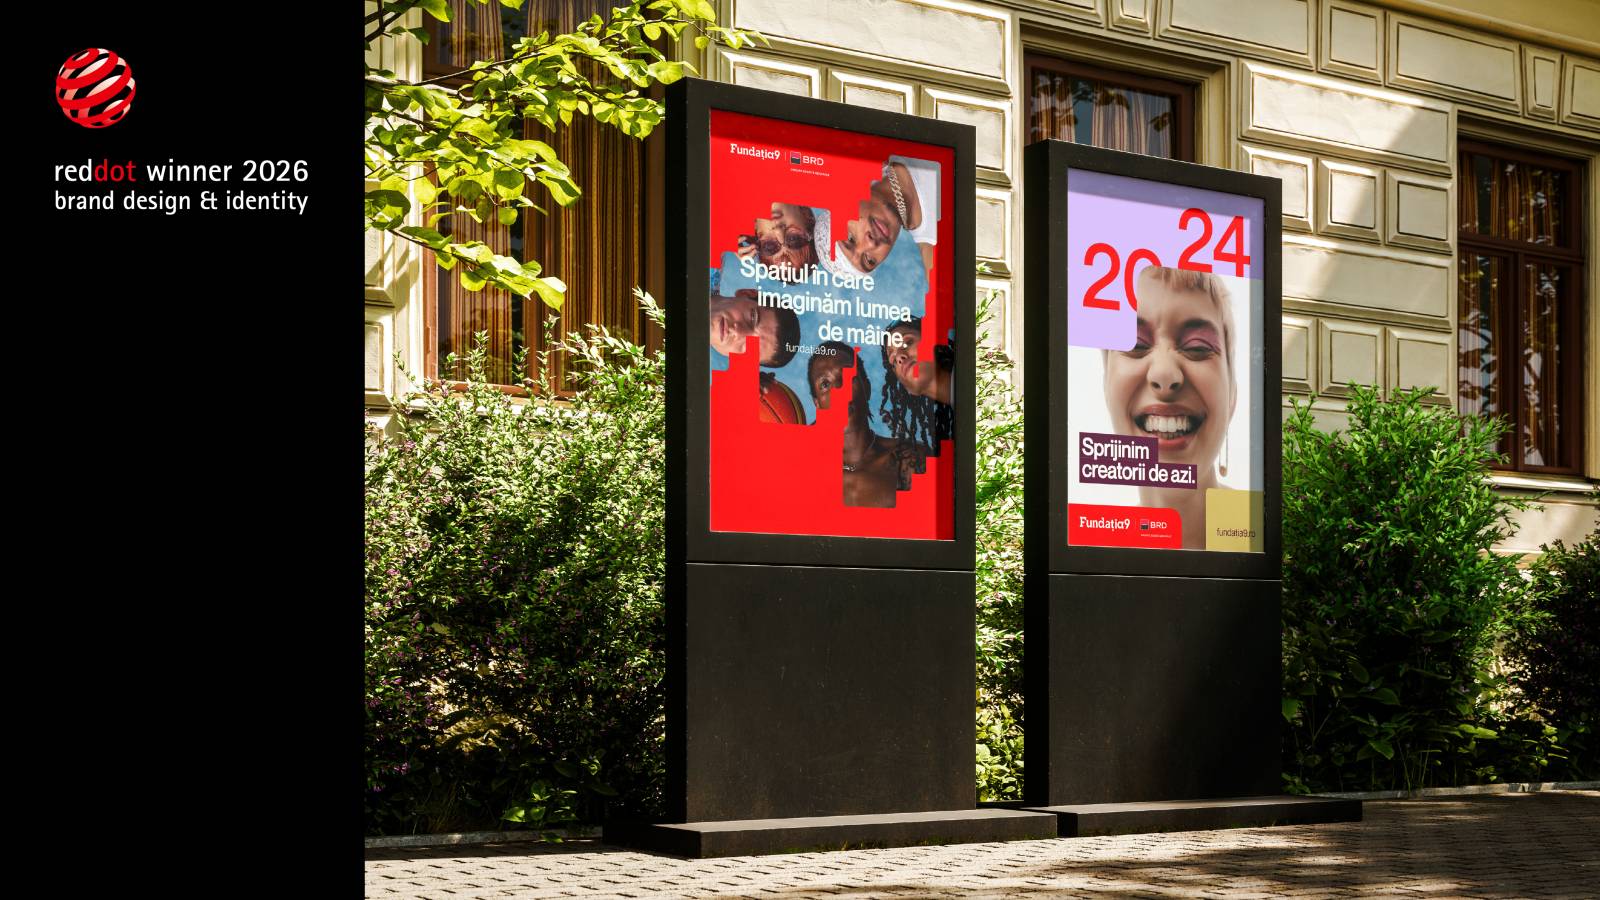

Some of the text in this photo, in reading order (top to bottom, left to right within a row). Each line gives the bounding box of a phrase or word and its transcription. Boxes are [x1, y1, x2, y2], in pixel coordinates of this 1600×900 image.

[802, 155, 824, 166] BRD
[1178, 207, 1251, 277] 24
[740, 256, 875, 292] Spațiul în care
[757, 286, 912, 323] imaginăm lumea
[818, 320, 908, 348] de mâine.
[1081, 437, 1150, 461] Sprijinim
[1081, 462, 1196, 484] creatorii de azi.
[1150, 521, 1168, 530] BRD
